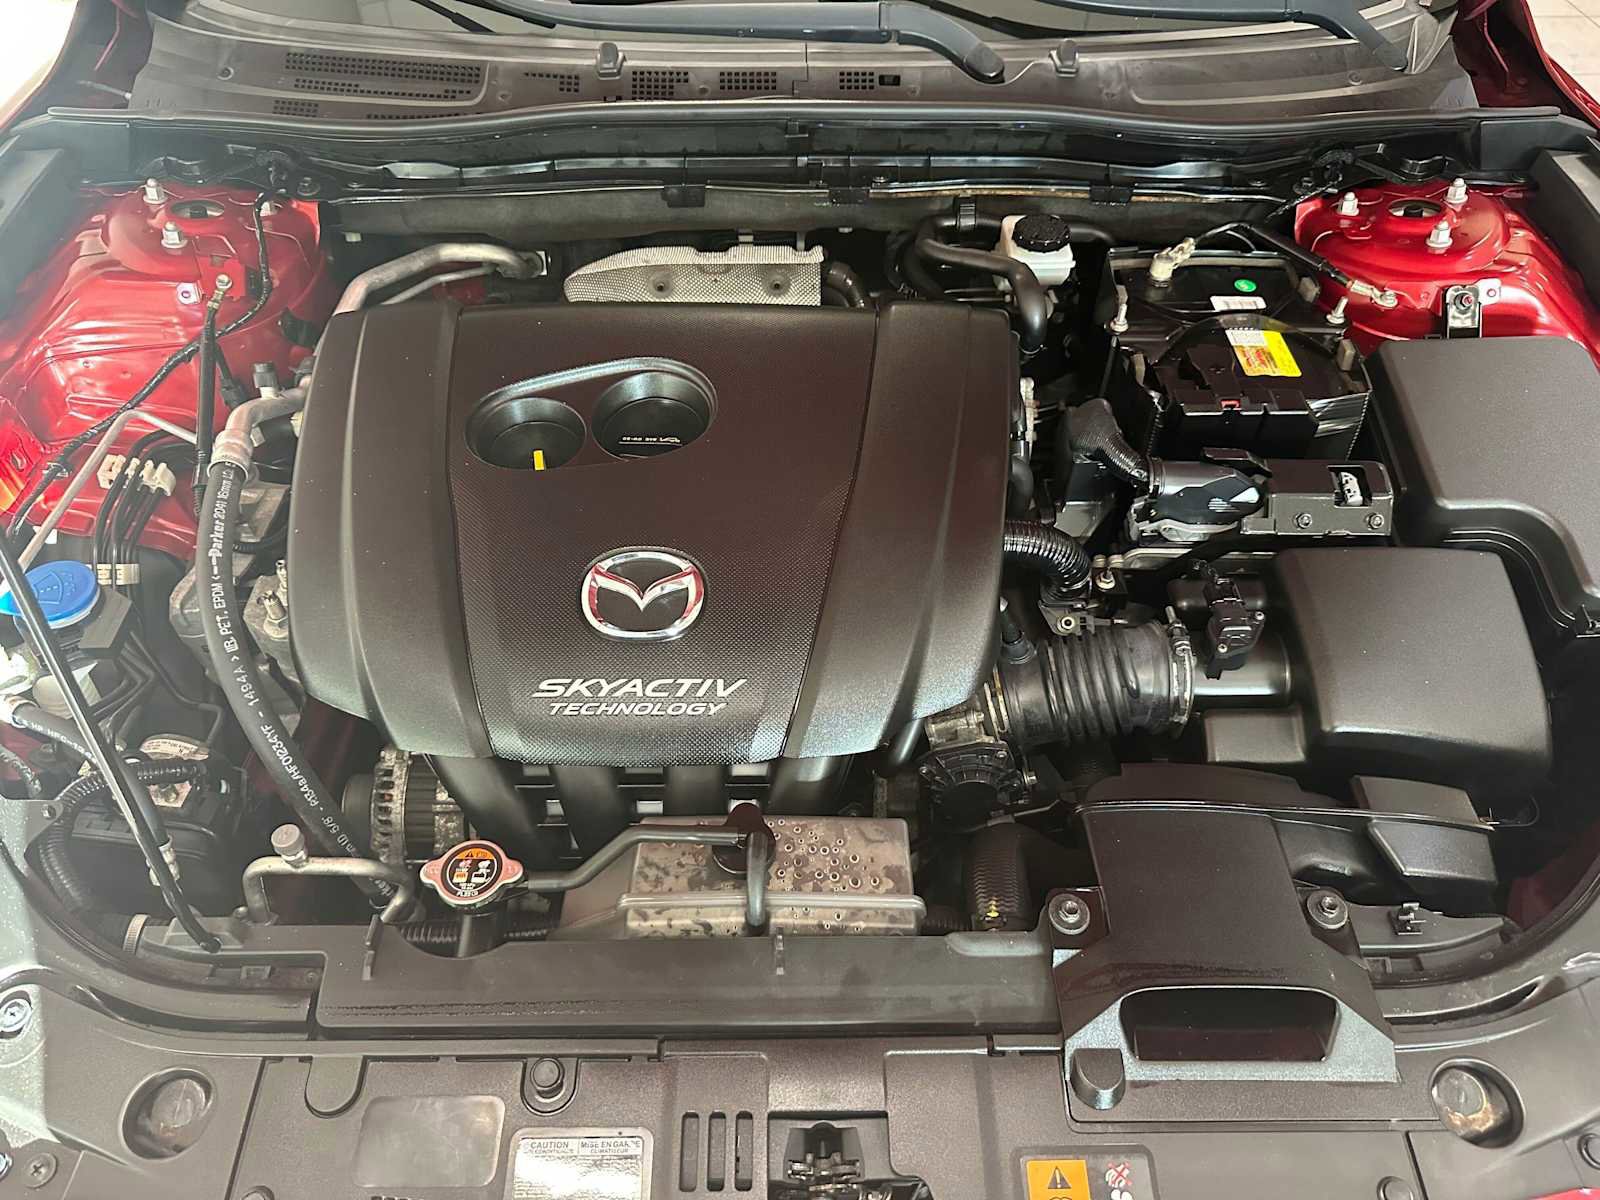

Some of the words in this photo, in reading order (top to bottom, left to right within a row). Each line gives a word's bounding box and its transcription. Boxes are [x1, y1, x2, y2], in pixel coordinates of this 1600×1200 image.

[208, 516, 225, 558] Parker
[211, 582, 226, 609] EPDM
[531, 678, 748, 698] SKYACTIV
[549, 702, 728, 716] TECHNOLOGY
[530, 1141, 569, 1149] CAUTION
